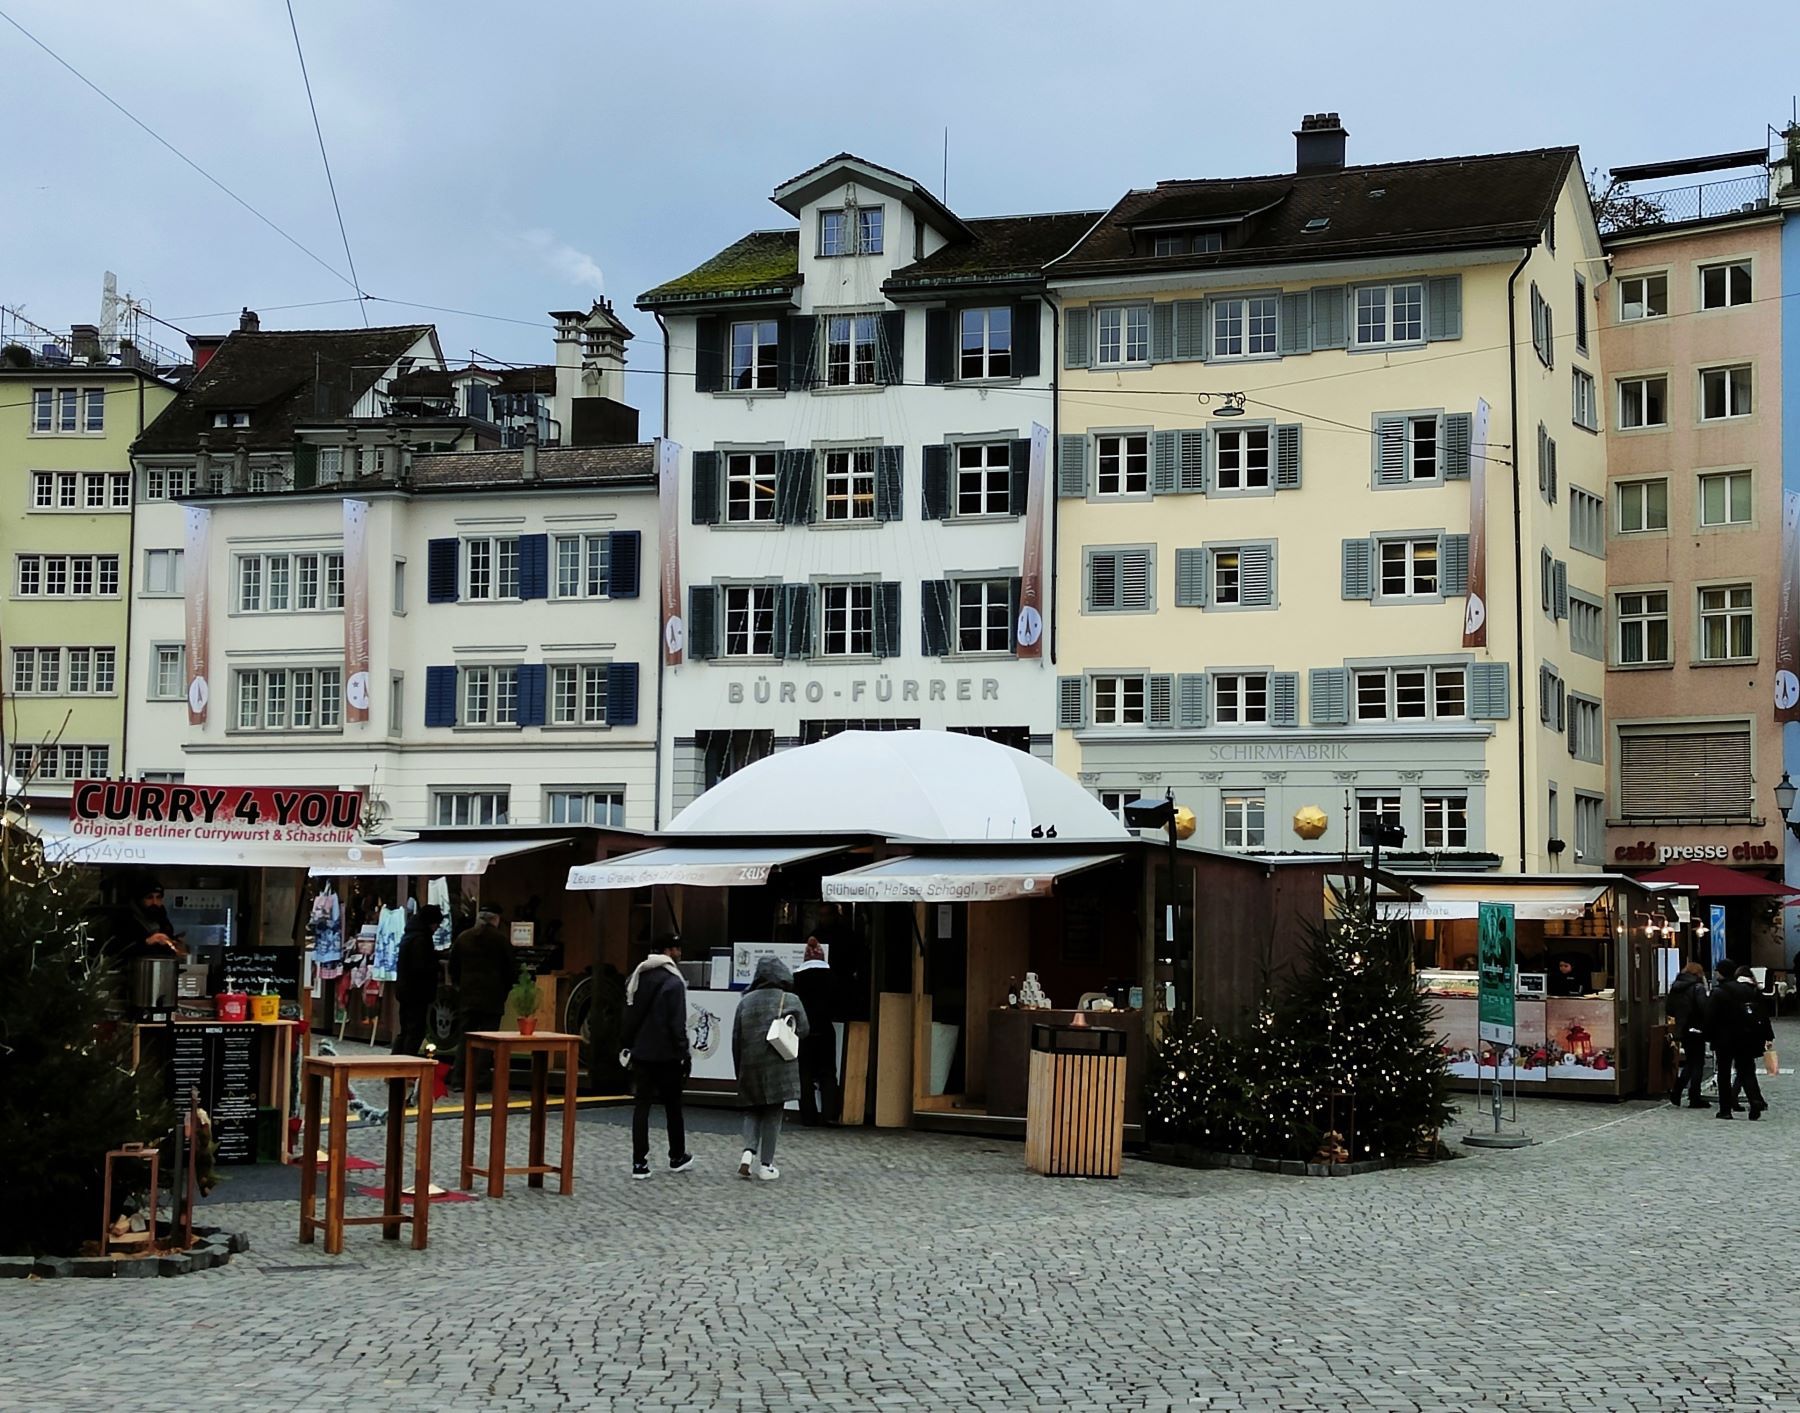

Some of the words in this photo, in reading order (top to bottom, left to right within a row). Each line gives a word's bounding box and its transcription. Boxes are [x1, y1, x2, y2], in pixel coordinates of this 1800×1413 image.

[728, 674, 999, 704] BÜRO-FÜRRER
[1209, 744, 1349, 760] SCHIRMFABRIK
[76, 783, 226, 823] CURRY
[234, 790, 260, 825] 4
[272, 792, 360, 829] YOU
[73, 821, 131, 837] Original
[134, 824, 192, 838] Berliner
[194, 826, 270, 842] Currywurst
[272, 830, 282, 841] &
[285, 829, 354, 842] Schaschlik
[1614, 841, 1656, 861] café
[1659, 844, 1728, 863] presse
[1732, 841, 1779, 861] club
[739, 866, 766, 880] ZEUS
[826, 883, 879, 896] Glühwein,
[884, 883, 922, 896] Heisse
[927, 882, 978, 898] Schoggi,
